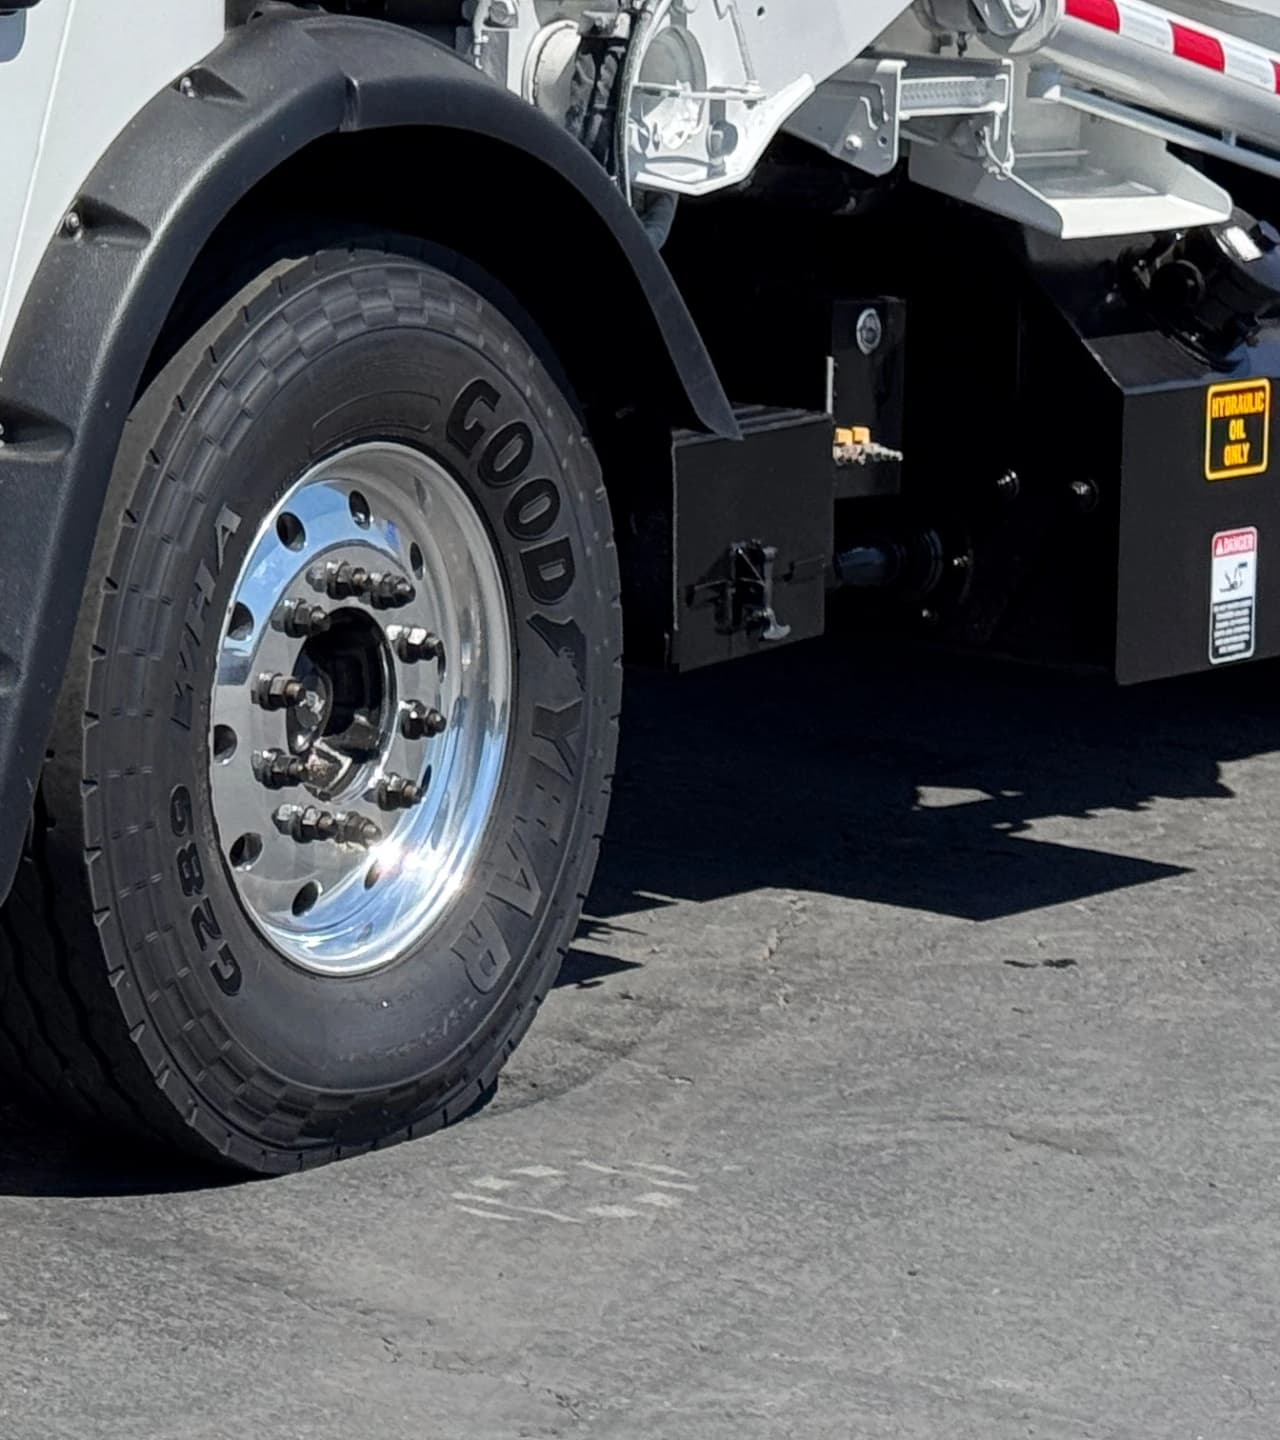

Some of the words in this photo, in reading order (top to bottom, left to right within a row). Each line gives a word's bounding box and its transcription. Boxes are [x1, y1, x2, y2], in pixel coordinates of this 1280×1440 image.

[1211, 390, 1265, 418] HYDRAULIC
[1229, 419, 1246, 440] OIL
[1224, 442, 1250, 466] ONLY
[1223, 532, 1254, 555] DANGER
[446, 378, 586, 994] GOODYEAR
[169, 782, 243, 998] G289
